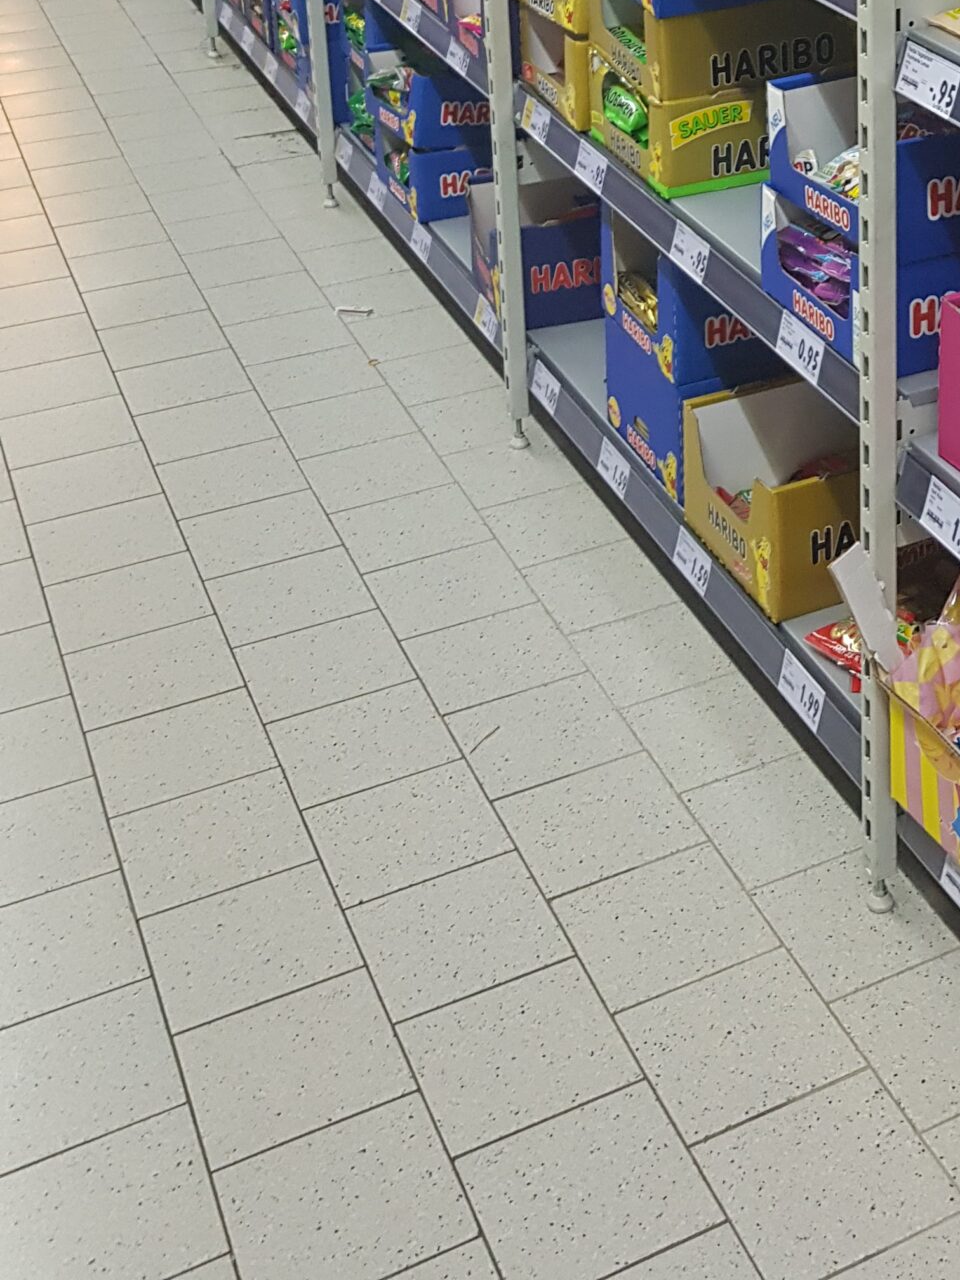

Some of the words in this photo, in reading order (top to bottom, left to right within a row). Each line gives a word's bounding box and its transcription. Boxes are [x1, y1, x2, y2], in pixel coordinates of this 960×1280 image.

[710, 33, 835, 88] HARIBO
[440, 101, 491, 127] HAR
[929, 79, 957, 109] -.95
[678, 104, 743, 139] SAUER
[711, 135, 770, 178] HAR
[804, 184, 851, 231] HARIBO
[530, 256, 601, 295] HARI
[621, 310, 653, 357] HARIBO
[792, 289, 835, 343] HARIBO
[795, 338, 822, 373] 0.95
[706, 500, 748, 560] HARIBO
[799, 680, 821, 718] 1.99
